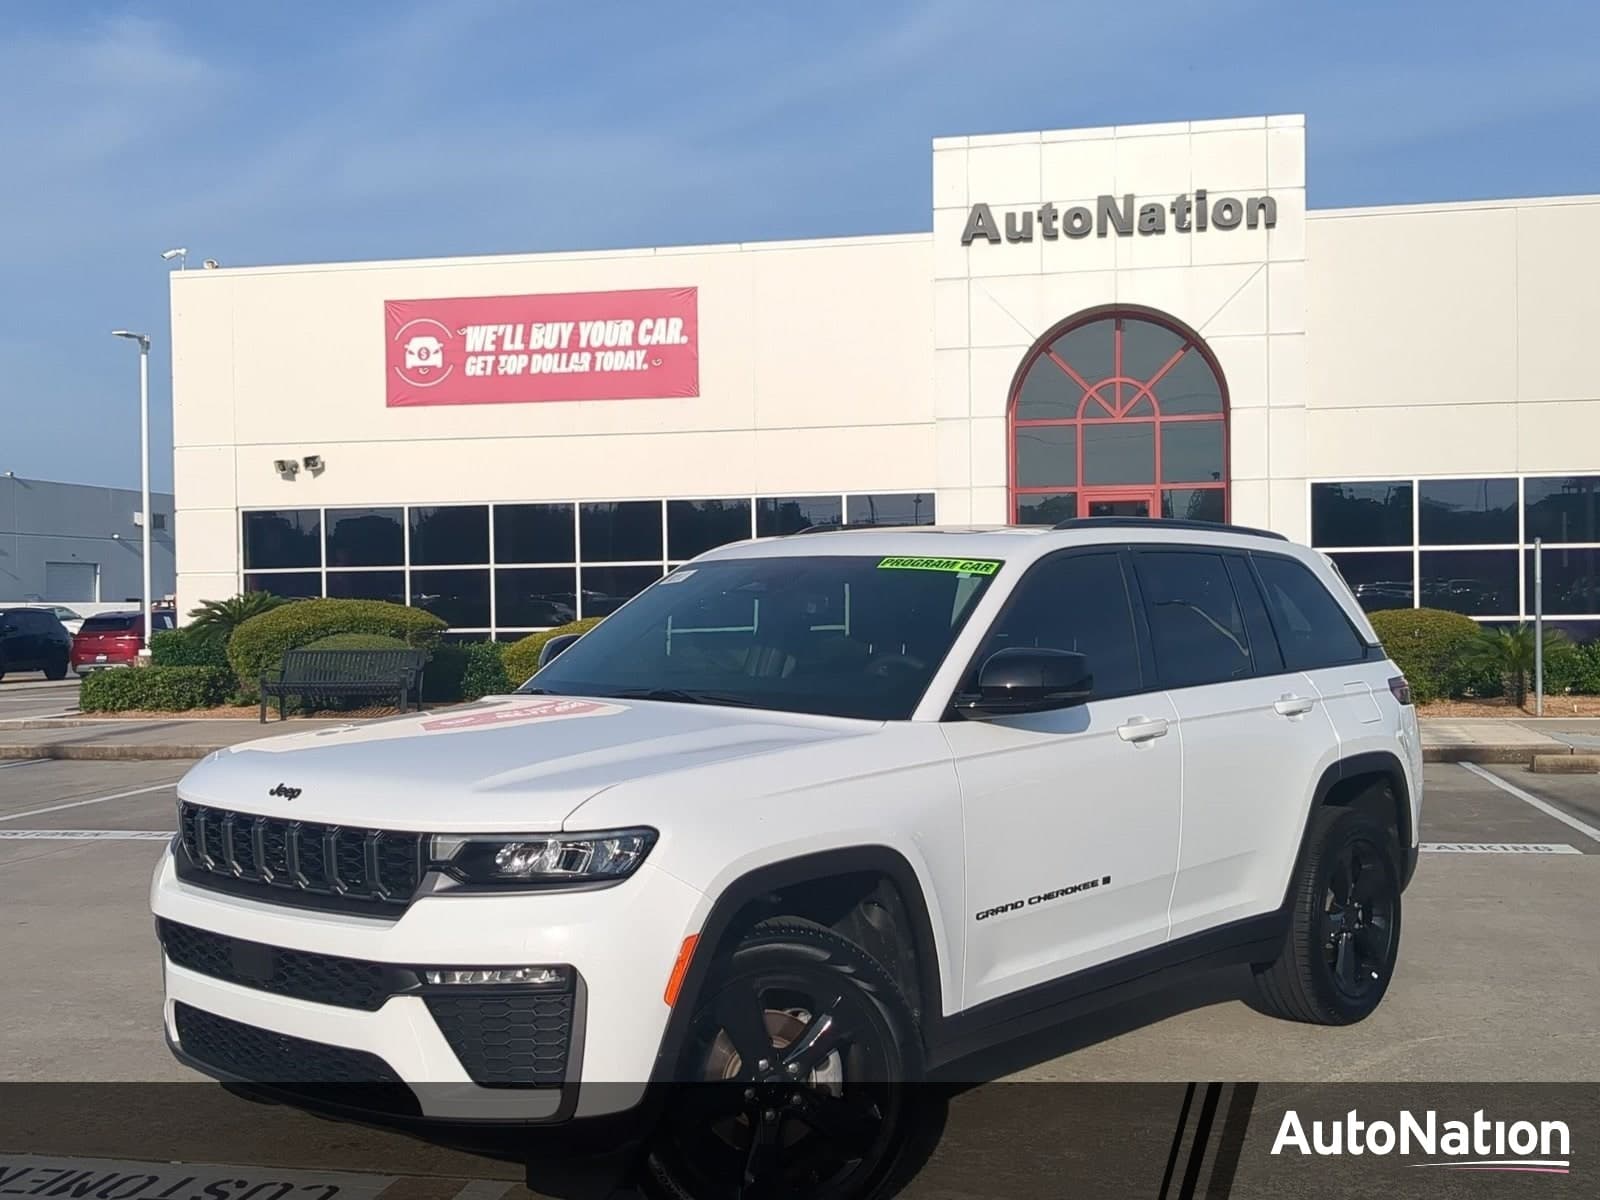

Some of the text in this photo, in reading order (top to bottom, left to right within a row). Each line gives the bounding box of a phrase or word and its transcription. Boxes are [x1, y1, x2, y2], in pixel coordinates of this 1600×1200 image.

[961, 189, 1277, 246] AutoNation
[464, 316, 688, 352] WE'LL BUY YOUR CAR.
[464, 350, 648, 376] GET TOP DOLLAR TODAY.
[881, 558, 995, 572] PROGRAM CAR
[269, 783, 302, 801] Jeep
[975, 879, 1100, 920] GRAND CHEROKEE
